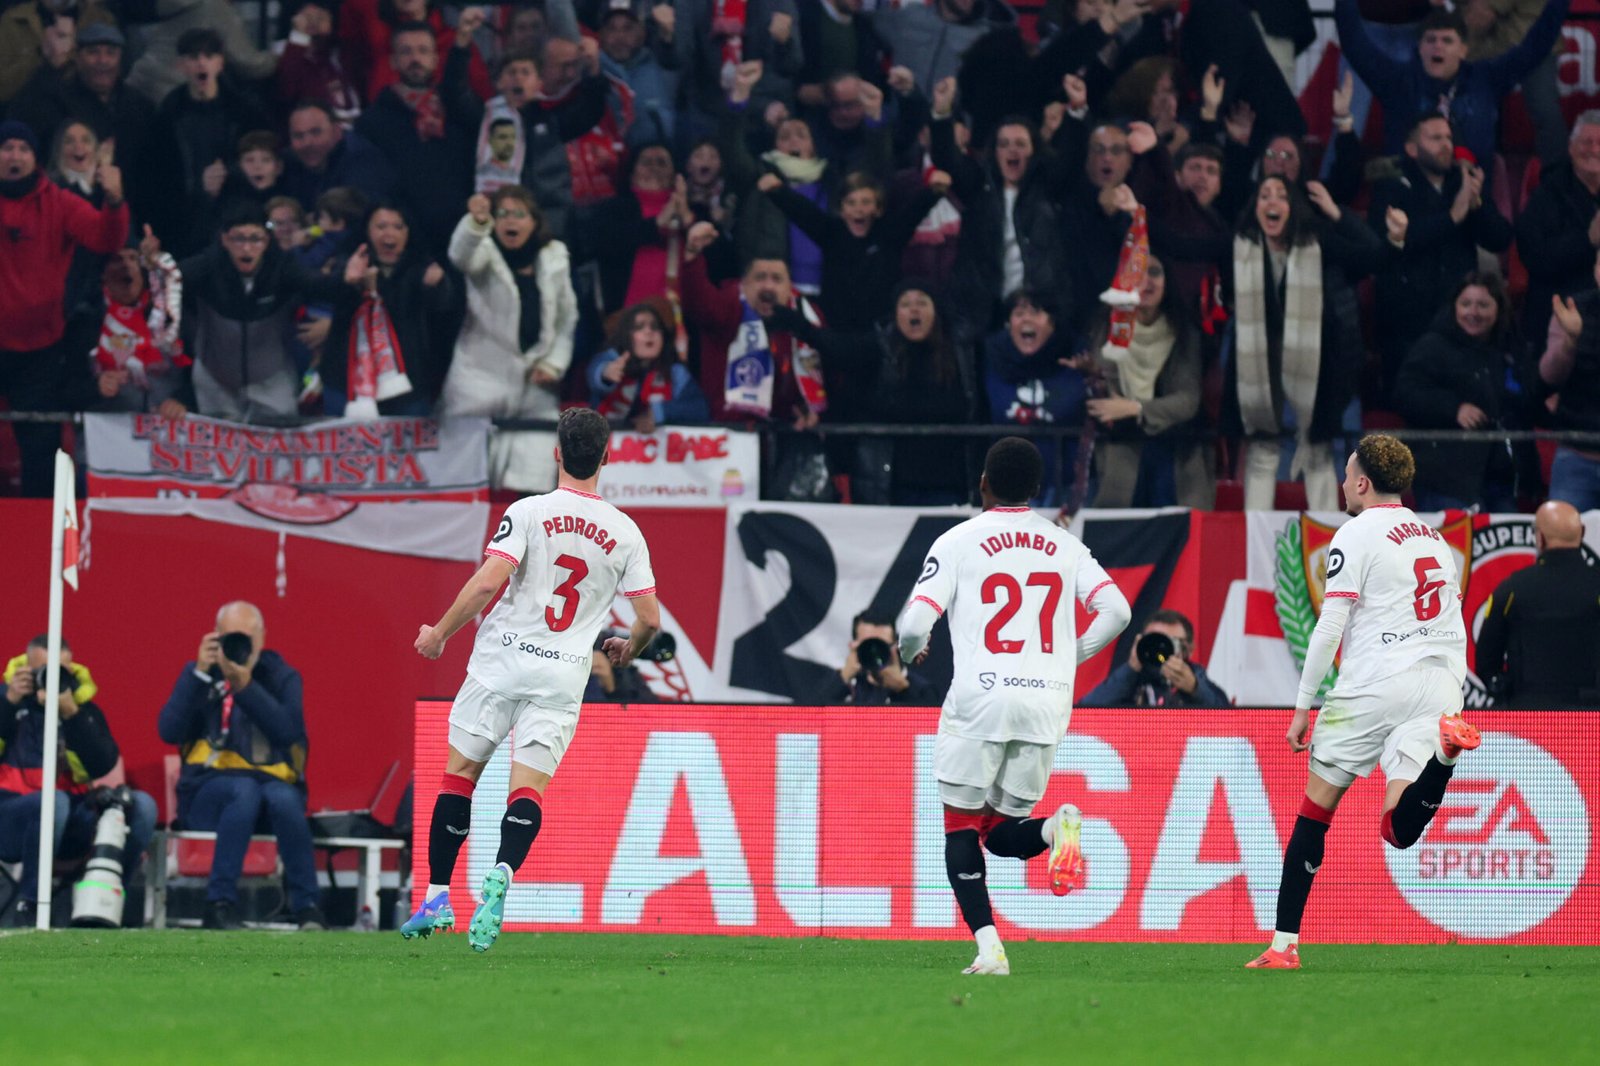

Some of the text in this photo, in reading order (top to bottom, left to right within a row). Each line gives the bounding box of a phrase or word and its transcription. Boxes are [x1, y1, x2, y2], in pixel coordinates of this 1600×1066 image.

[133, 413, 439, 452] ETERNAMENTE
[151, 442, 427, 486] SEVILLISTA
[542, 515, 618, 555] PEDROSA
[980, 531, 1058, 557] IDUMBO
[1386, 522, 1440, 546] VARGAS
[544, 553, 589, 632] 3
[1413, 556, 1447, 621] 6
[980, 571, 1063, 654] 27
[519, 641, 588, 666] socios.com
[1003, 676, 1070, 692] socios.com
[1424, 779, 1551, 844] EA
[1418, 848, 1554, 880] SPORTS
